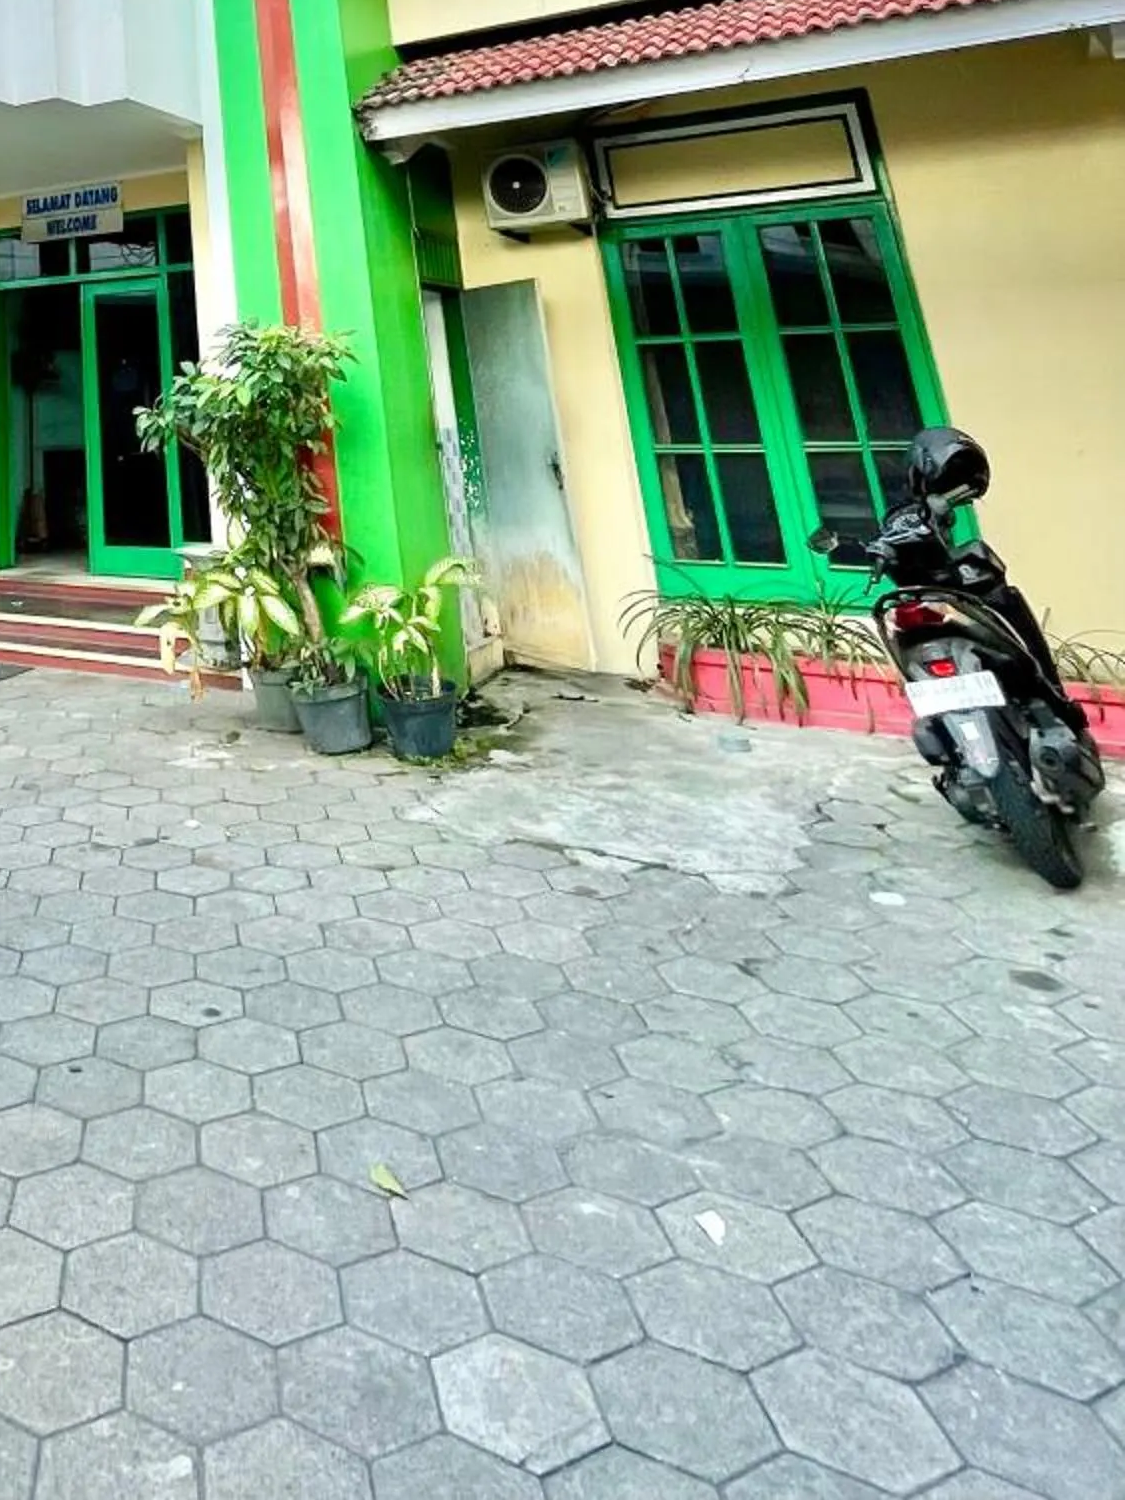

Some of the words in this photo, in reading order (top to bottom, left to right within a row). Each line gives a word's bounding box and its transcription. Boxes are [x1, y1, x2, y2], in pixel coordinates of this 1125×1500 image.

[26, 194, 71, 214] SELAMAT
[74, 186, 118, 208] DATANG
[46, 214, 97, 236] WELCOME
